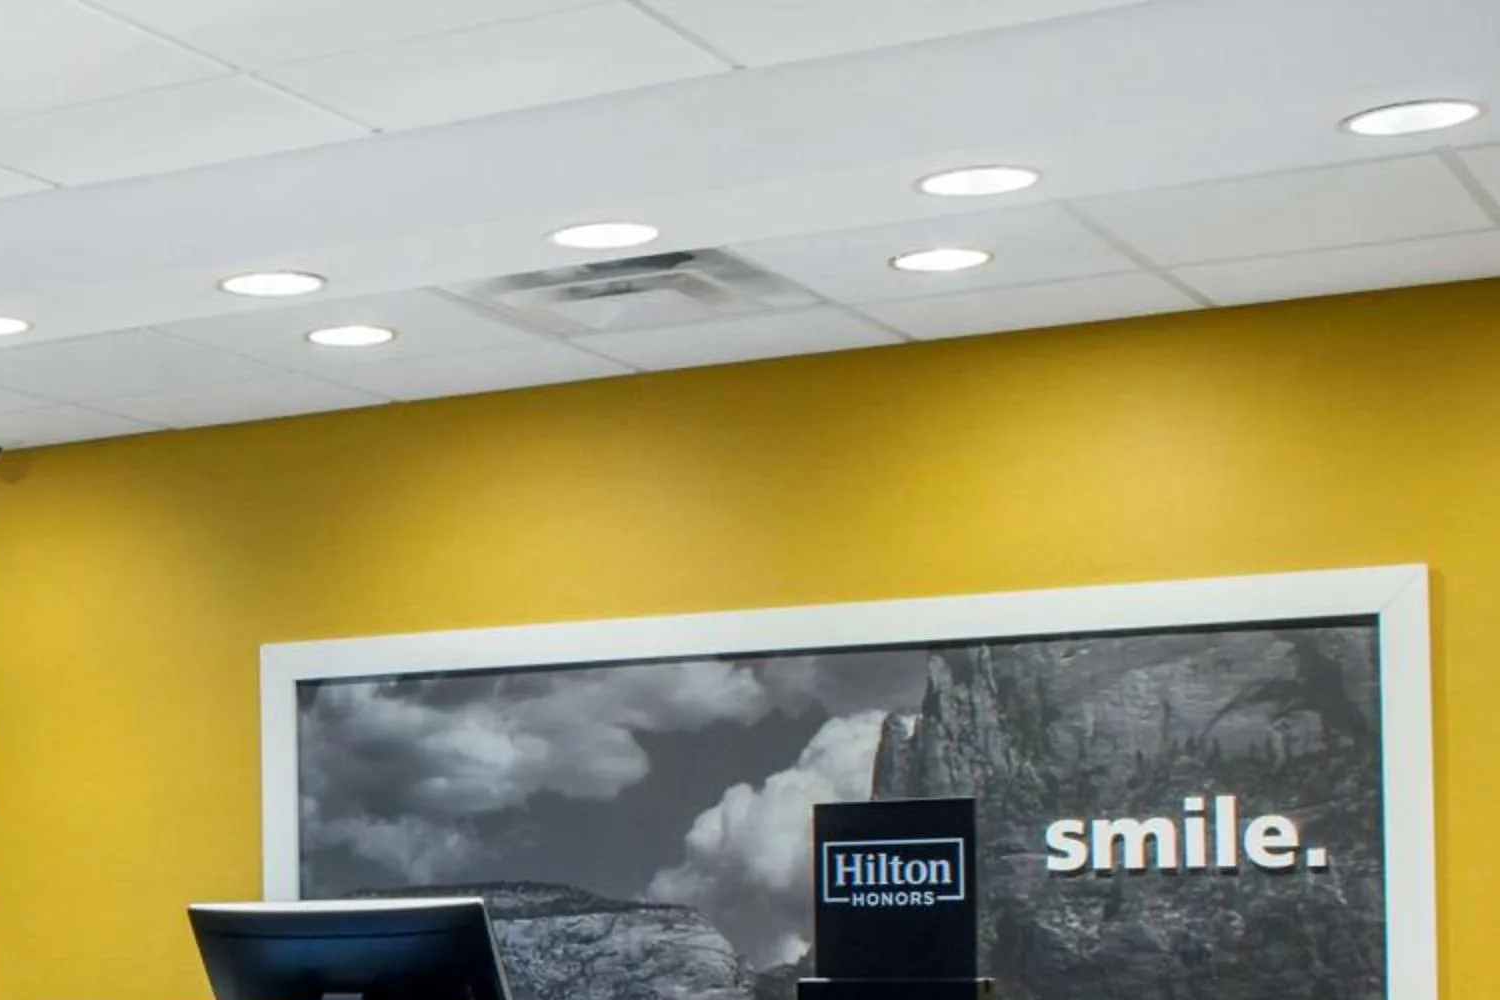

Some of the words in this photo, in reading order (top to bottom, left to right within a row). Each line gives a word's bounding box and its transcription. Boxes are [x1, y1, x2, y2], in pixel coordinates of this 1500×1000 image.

[1045, 795, 1328, 873] smile.
[835, 852, 953, 887] Hilton
[851, 891, 936, 907] HONORS
